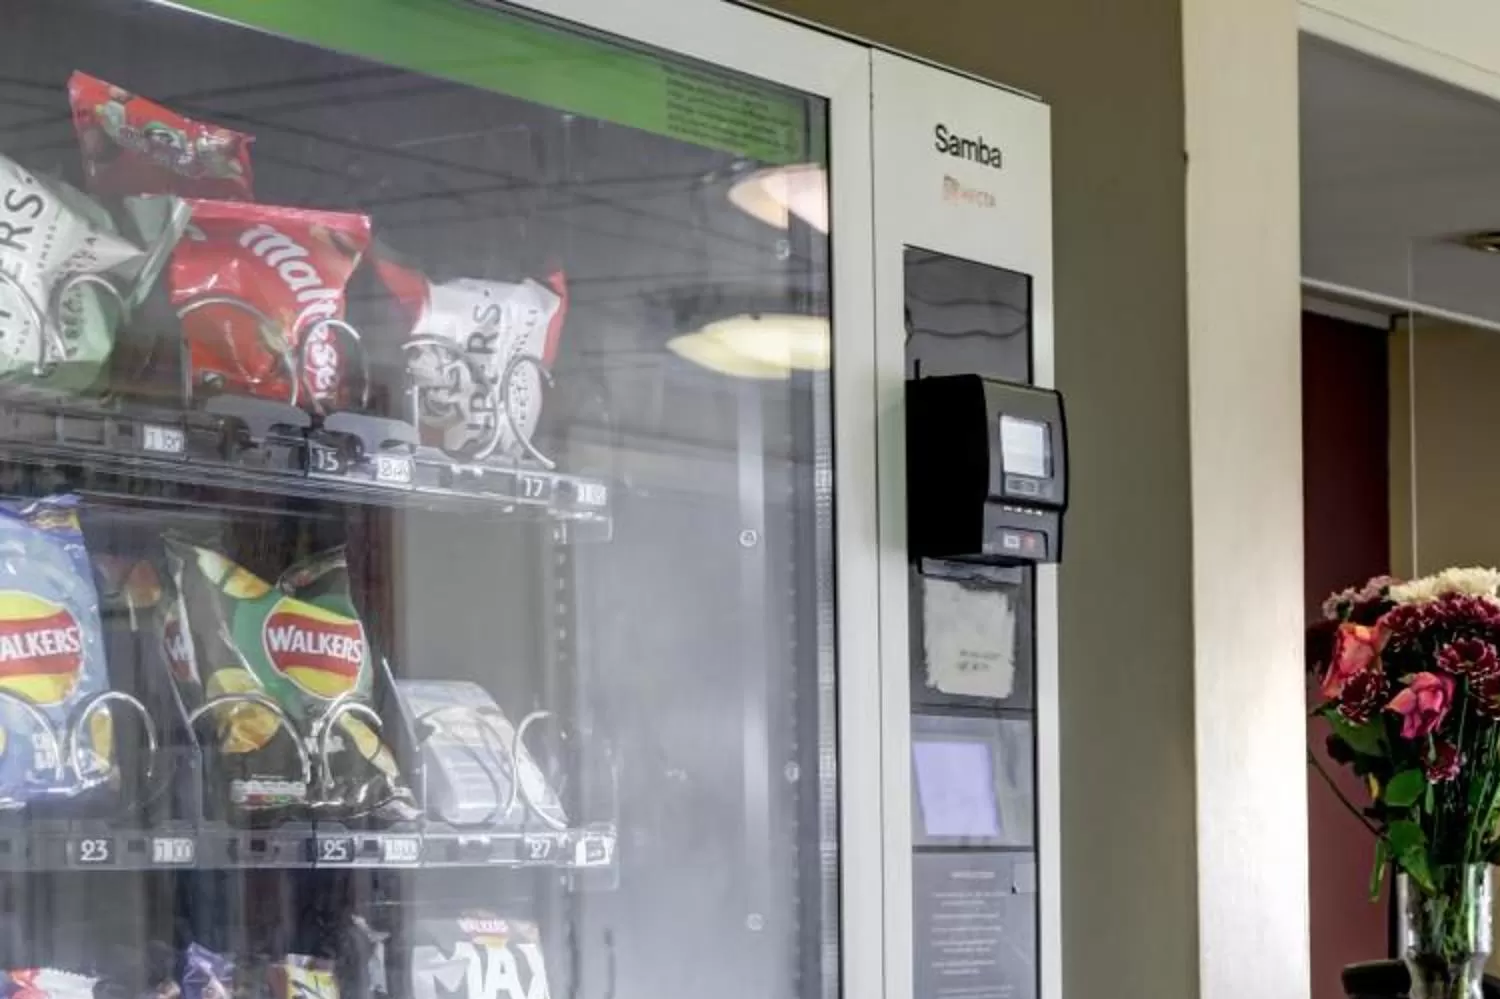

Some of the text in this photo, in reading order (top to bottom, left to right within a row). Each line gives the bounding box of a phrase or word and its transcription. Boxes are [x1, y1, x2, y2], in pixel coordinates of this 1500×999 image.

[935, 123, 1002, 169] Samba
[318, 449, 340, 471] 15
[525, 477, 542, 497] 17
[0, 627, 81, 662] ALKERS
[267, 624, 364, 664] WALKERS
[80, 839, 108, 861] 23
[323, 839, 348, 861] 25
